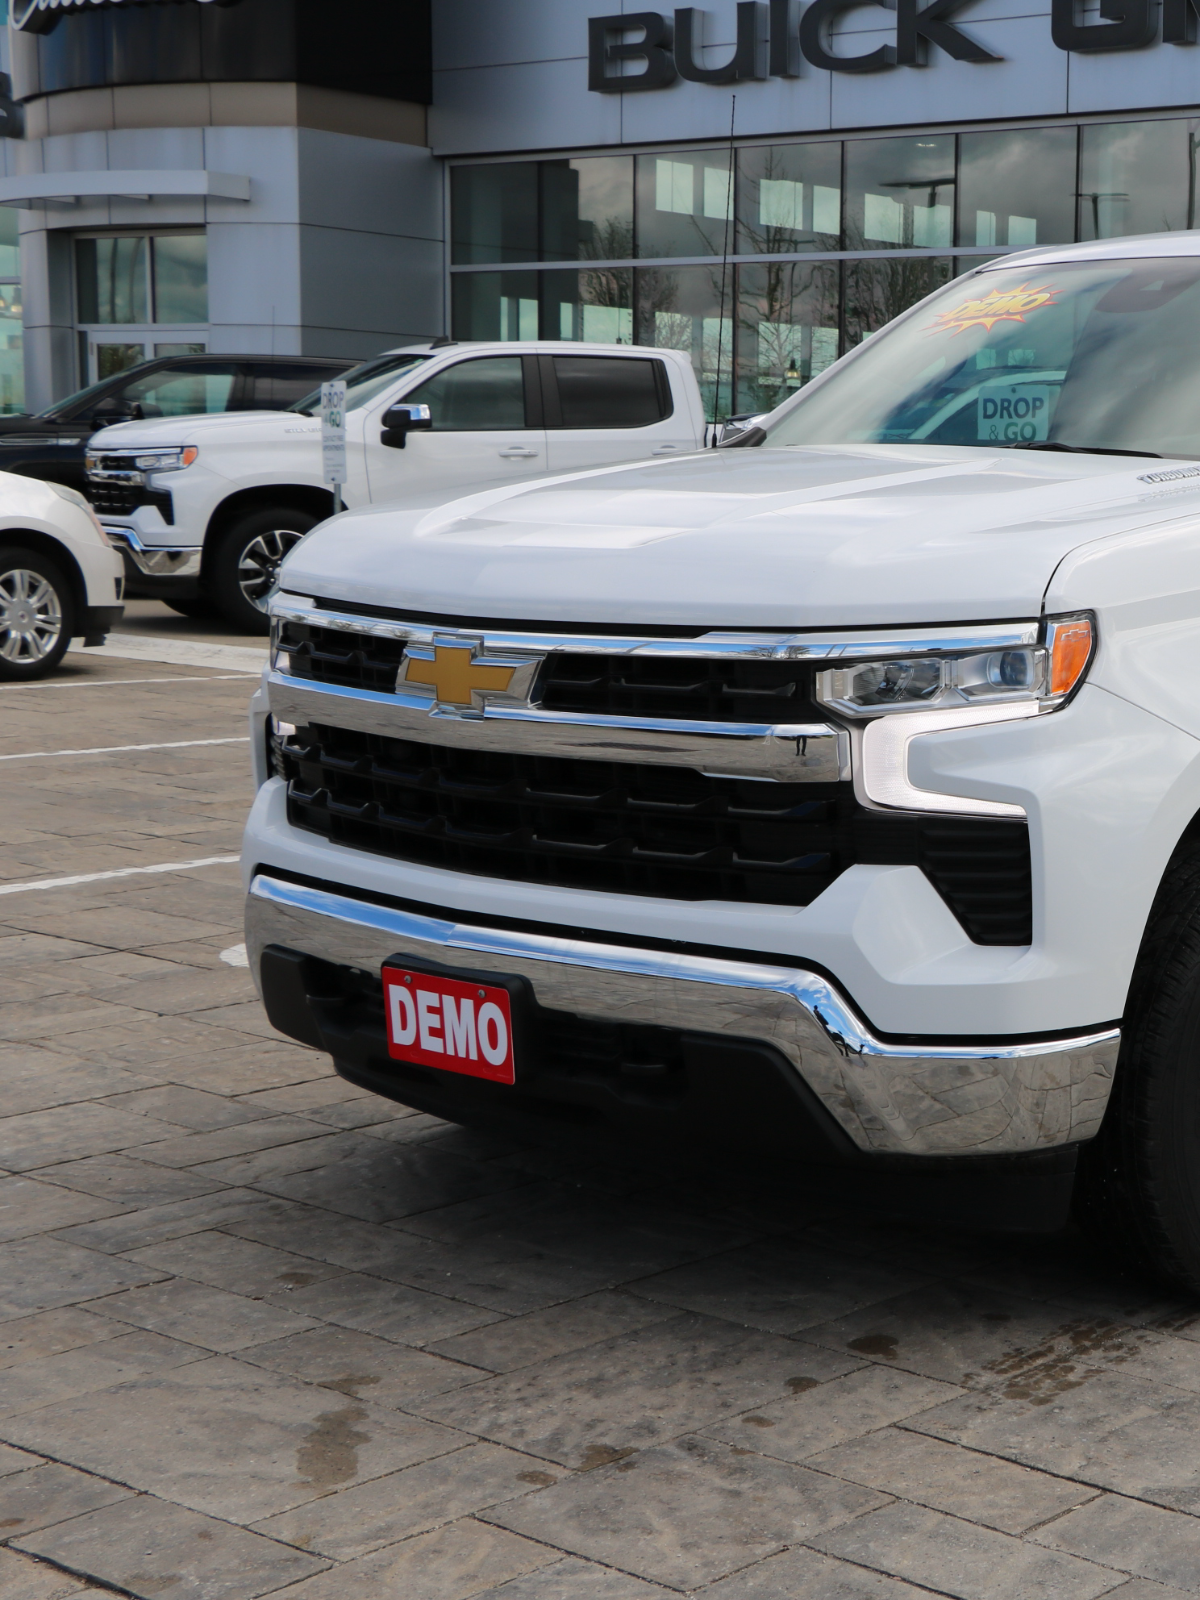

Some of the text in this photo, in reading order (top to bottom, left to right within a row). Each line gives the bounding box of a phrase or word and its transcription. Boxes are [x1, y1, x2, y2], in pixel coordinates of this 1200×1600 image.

[588, 0, 1004, 93] BUICK
[937, 292, 1052, 323] DEMO
[982, 397, 1044, 420] DROP
[988, 421, 1037, 441] & GO
[388, 983, 509, 1066] DEMO
